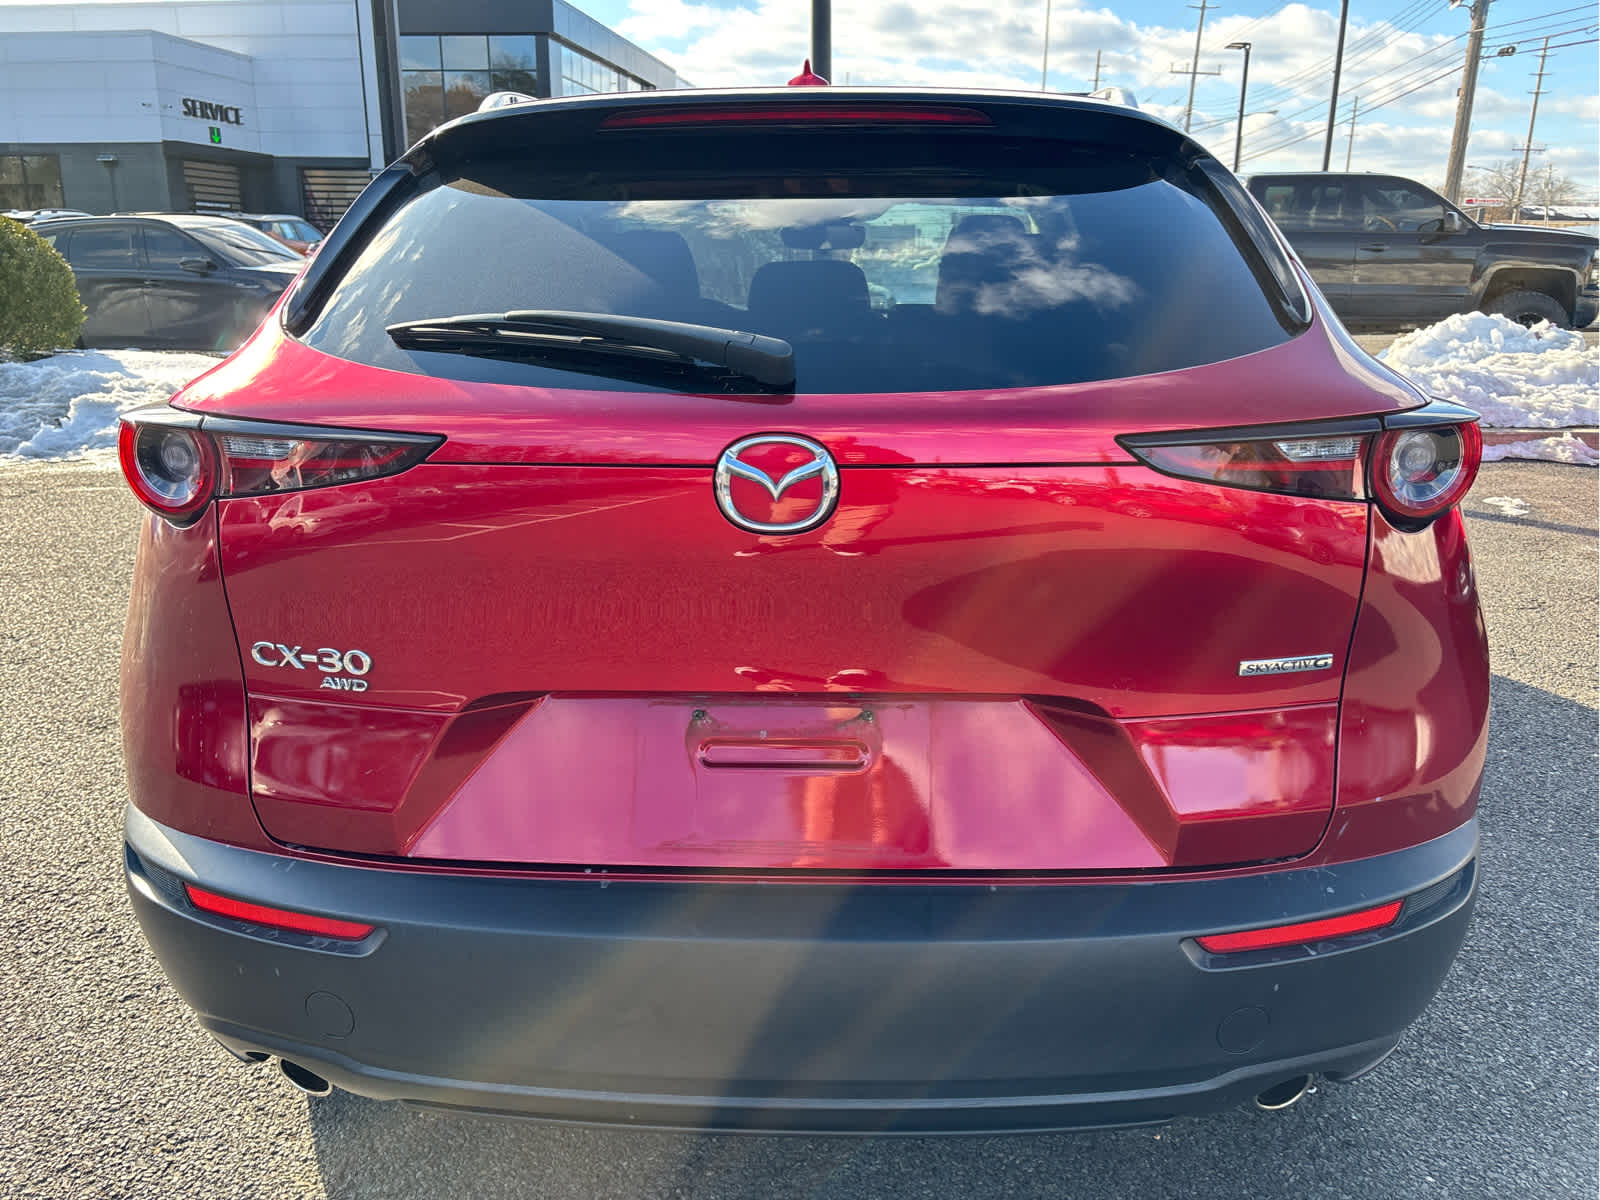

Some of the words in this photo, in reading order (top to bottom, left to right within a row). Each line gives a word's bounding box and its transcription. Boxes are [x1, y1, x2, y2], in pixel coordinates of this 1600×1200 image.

[182, 97, 245, 126] SERVICE
[251, 641, 372, 675] CX-30
[320, 676, 368, 692] AWD
